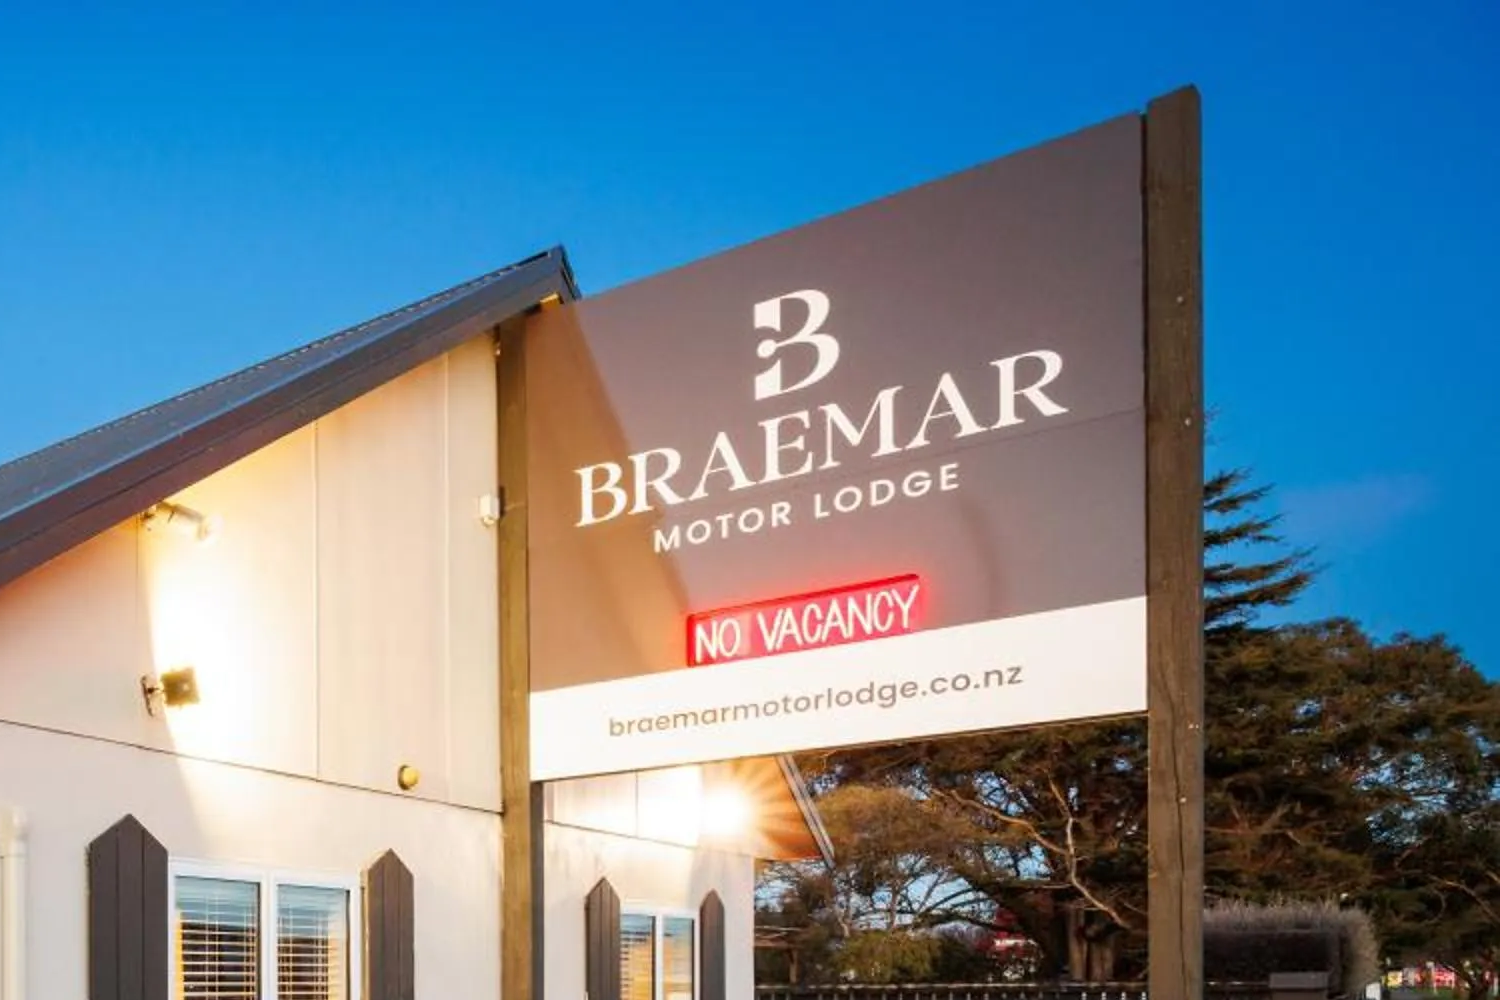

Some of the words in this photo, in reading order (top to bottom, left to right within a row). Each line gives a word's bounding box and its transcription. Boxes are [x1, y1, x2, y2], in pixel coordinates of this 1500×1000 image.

[754, 289, 840, 401] B
[573, 349, 1069, 528] BRAEMAR
[653, 501, 792, 553] MOTOR
[814, 462, 960, 519] LODGE
[694, 617, 741, 663] NO
[756, 584, 920, 652] VACANCY
[608, 665, 1024, 737] braemarmotorlodge.co.nz
